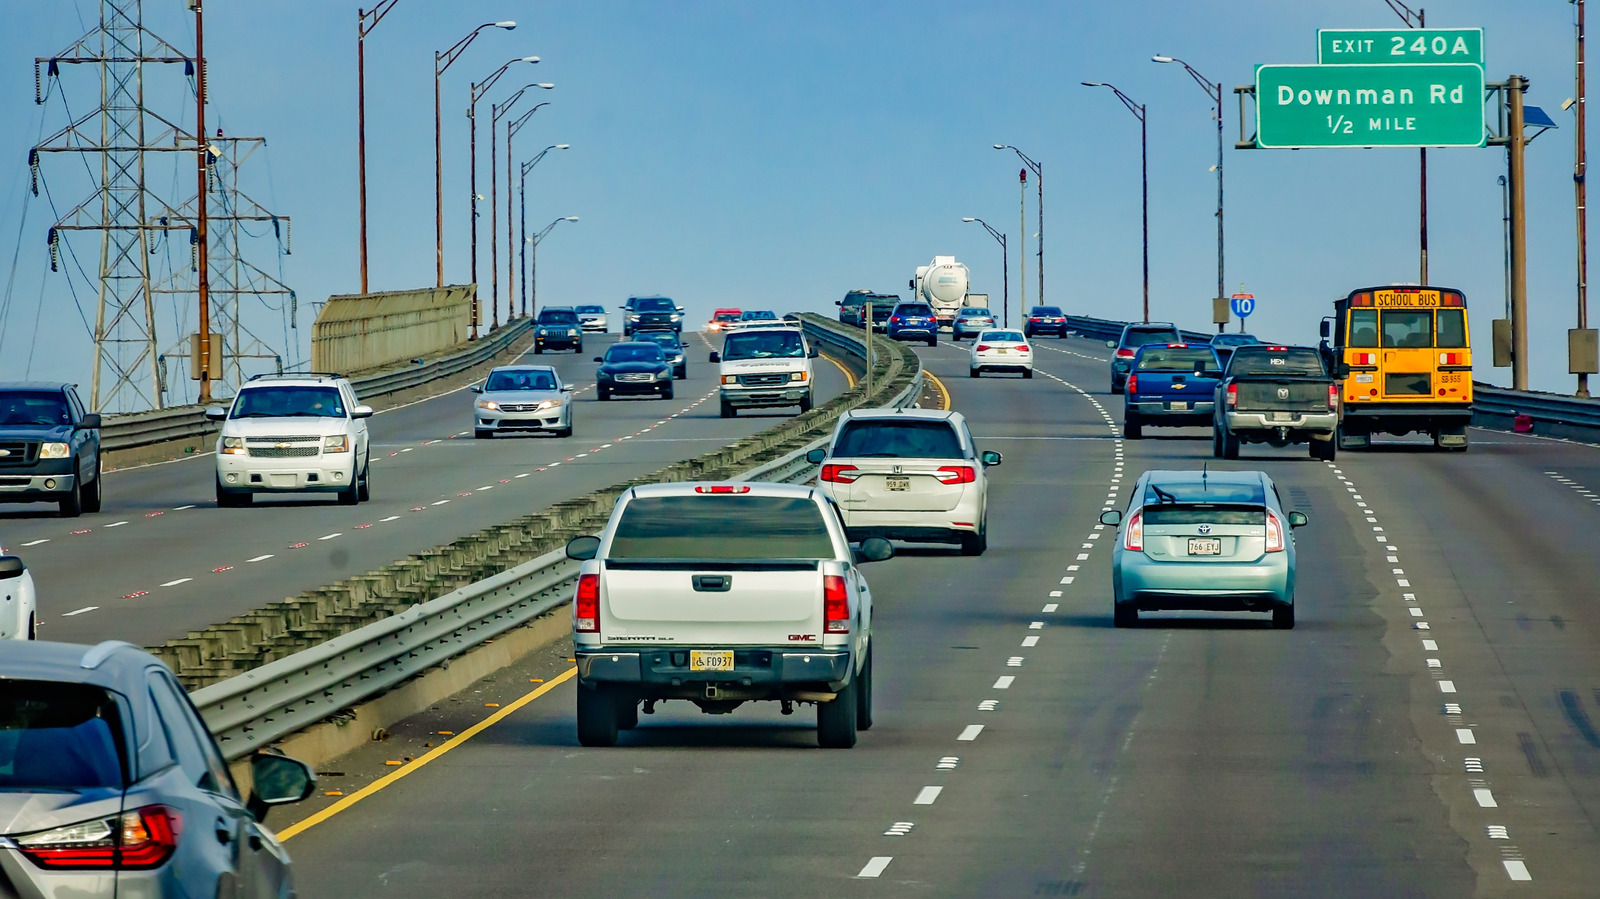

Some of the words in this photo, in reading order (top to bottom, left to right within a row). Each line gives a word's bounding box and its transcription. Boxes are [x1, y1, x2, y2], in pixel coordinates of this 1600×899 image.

[1332, 40, 1374, 53] EXIT
[1390, 36, 1469, 55] 240A
[1278, 85, 1414, 105] Downman
[1430, 84, 1463, 104] Rd
[1327, 115, 1353, 134] 1/2
[1369, 117, 1416, 131] MILE
[1235, 299, 1252, 313] 10
[1378, 293, 1413, 306] SCHOOL
[1418, 293, 1437, 306] BUS
[1190, 543, 1203, 551] 766
[1206, 543, 1219, 551] EYJ
[706, 656, 732, 667] F0937
